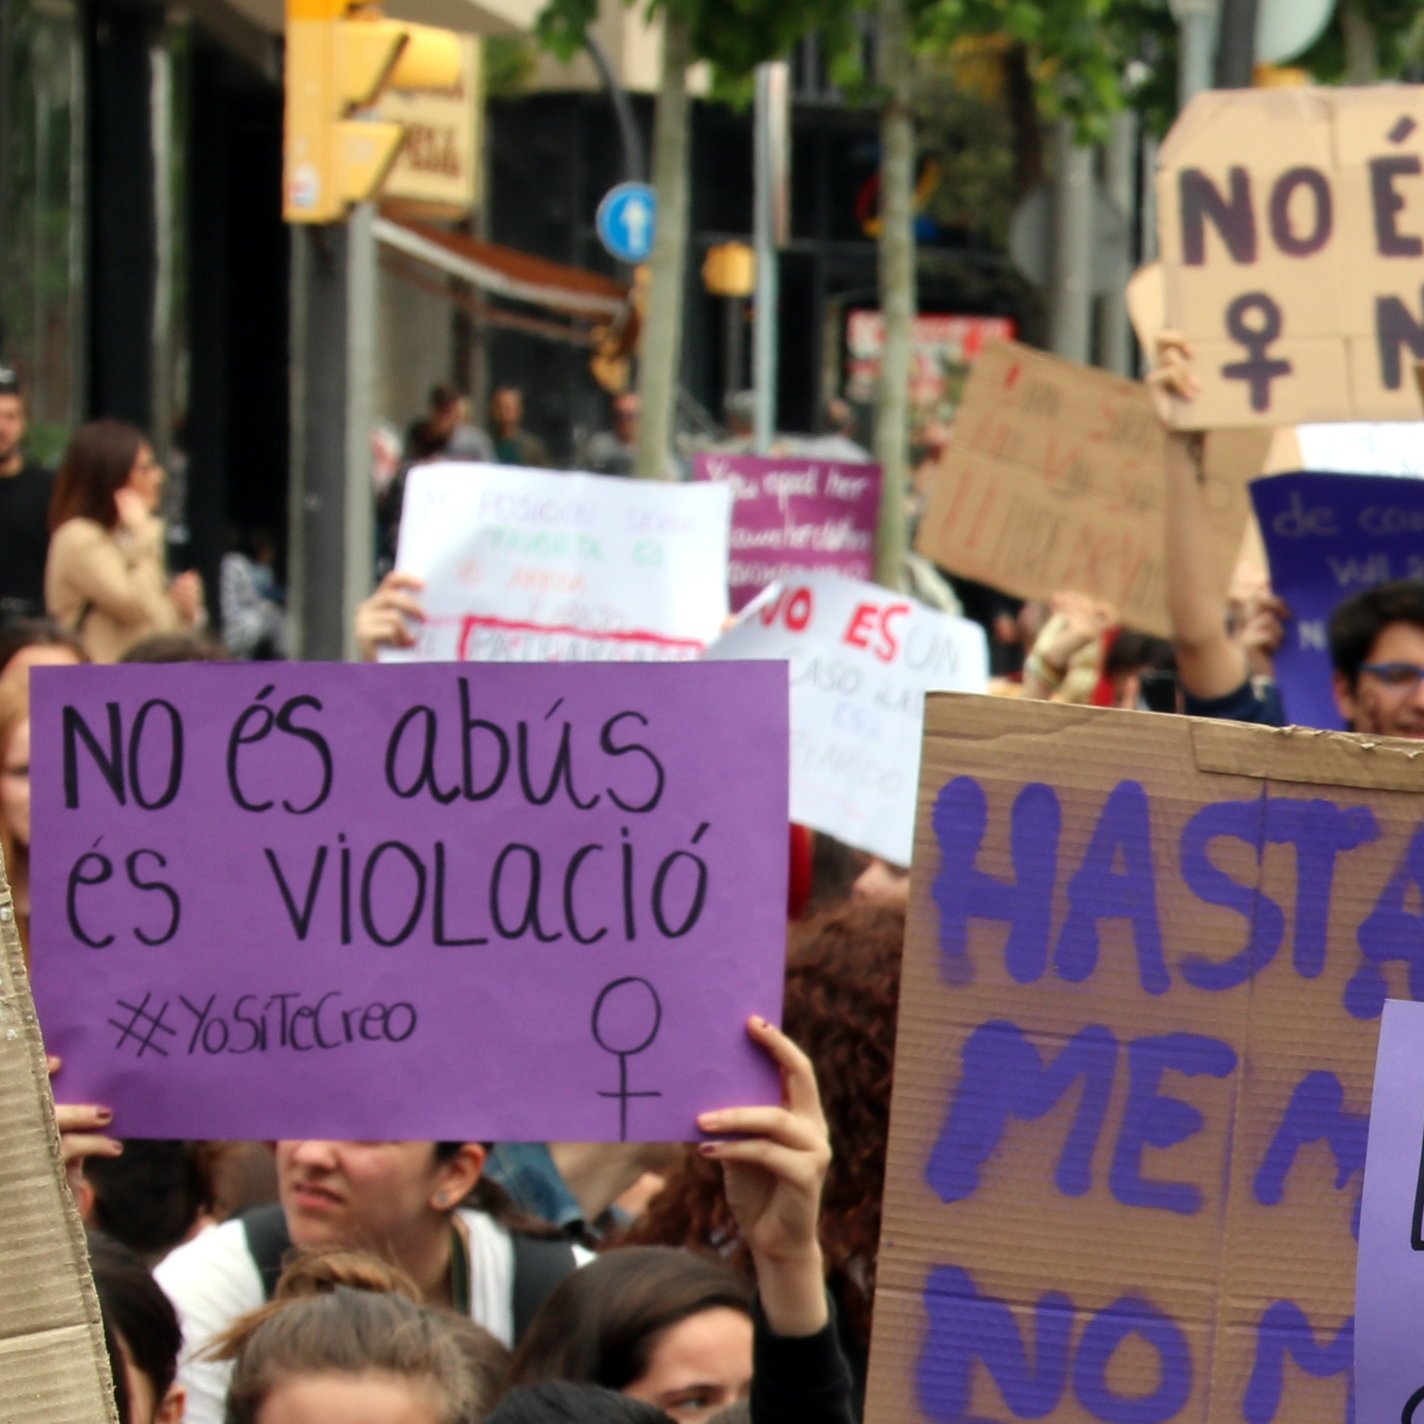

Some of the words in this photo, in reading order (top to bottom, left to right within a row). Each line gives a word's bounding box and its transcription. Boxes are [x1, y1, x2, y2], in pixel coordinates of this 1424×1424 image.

[1179, 163, 1333, 267] NO
[61, 697, 185, 812] NO
[383, 676, 667, 815] abús
[65, 835, 182, 951] és
[924, 1019, 1239, 1217] ME
